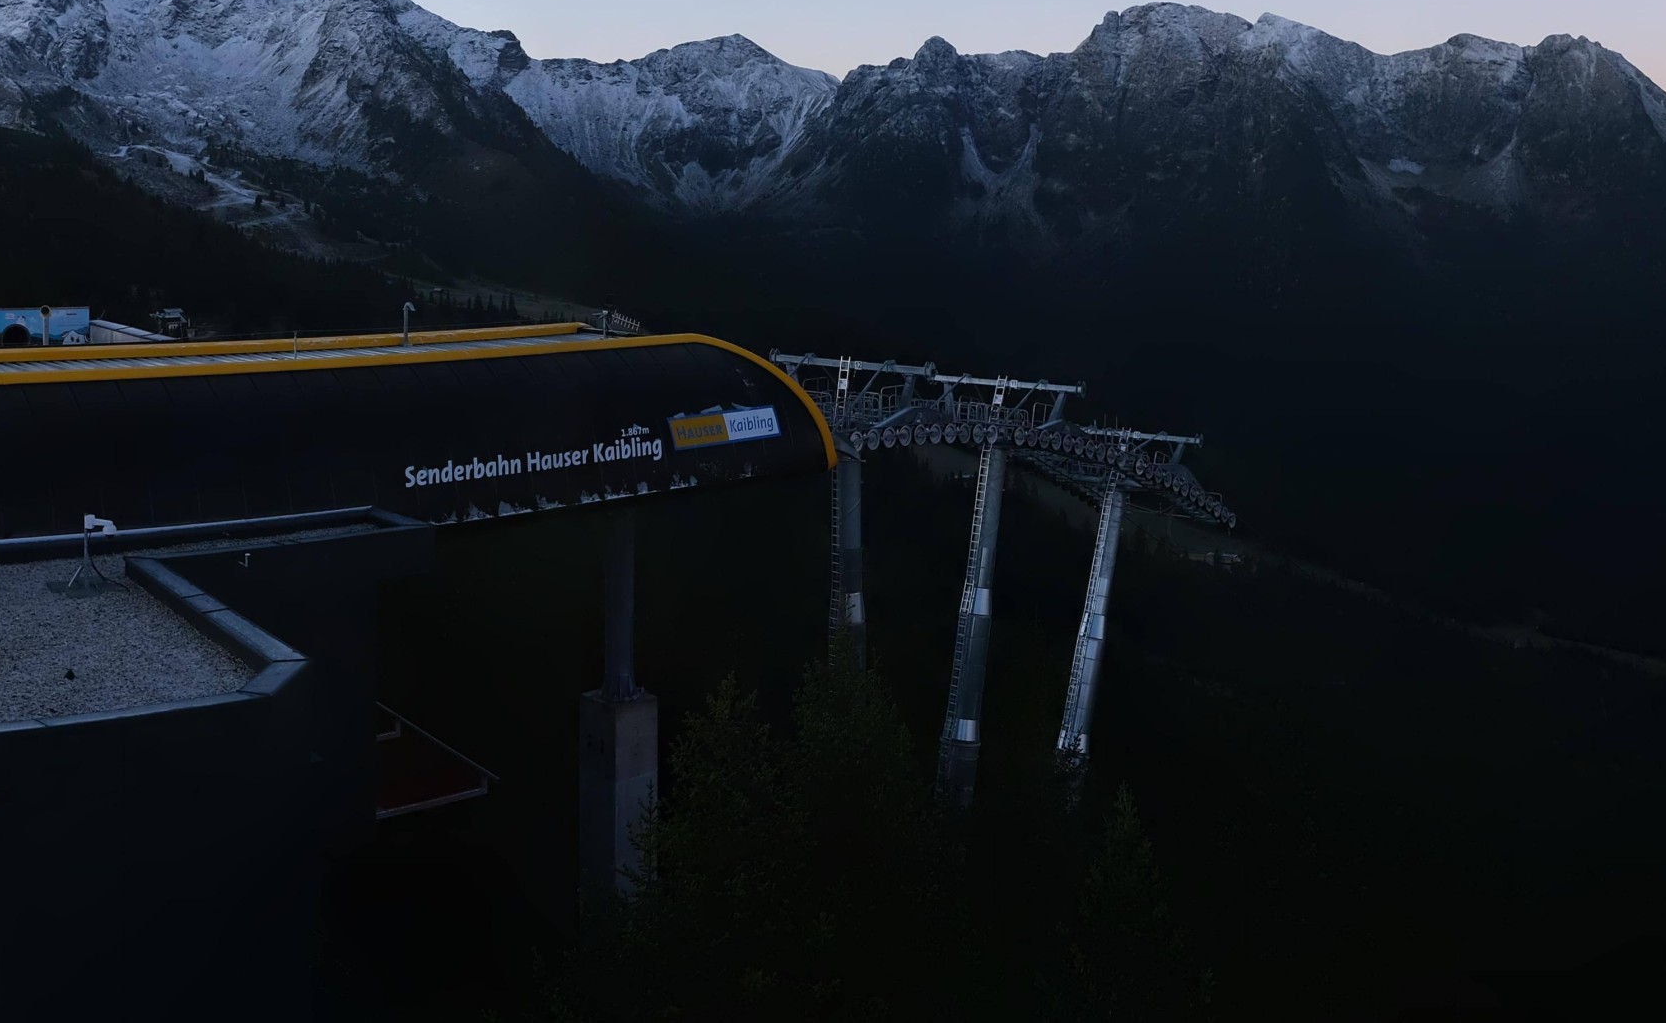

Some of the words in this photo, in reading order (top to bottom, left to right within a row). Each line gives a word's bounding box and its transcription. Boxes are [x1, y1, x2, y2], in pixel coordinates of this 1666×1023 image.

[621, 425, 650, 438] 1.867m
[675, 424, 723, 441] HAUSER
[729, 414, 774, 434] Kaibling
[404, 454, 522, 488] Senderbahn
[526, 444, 590, 473] Hauser
[592, 437, 664, 464] Kaibling
